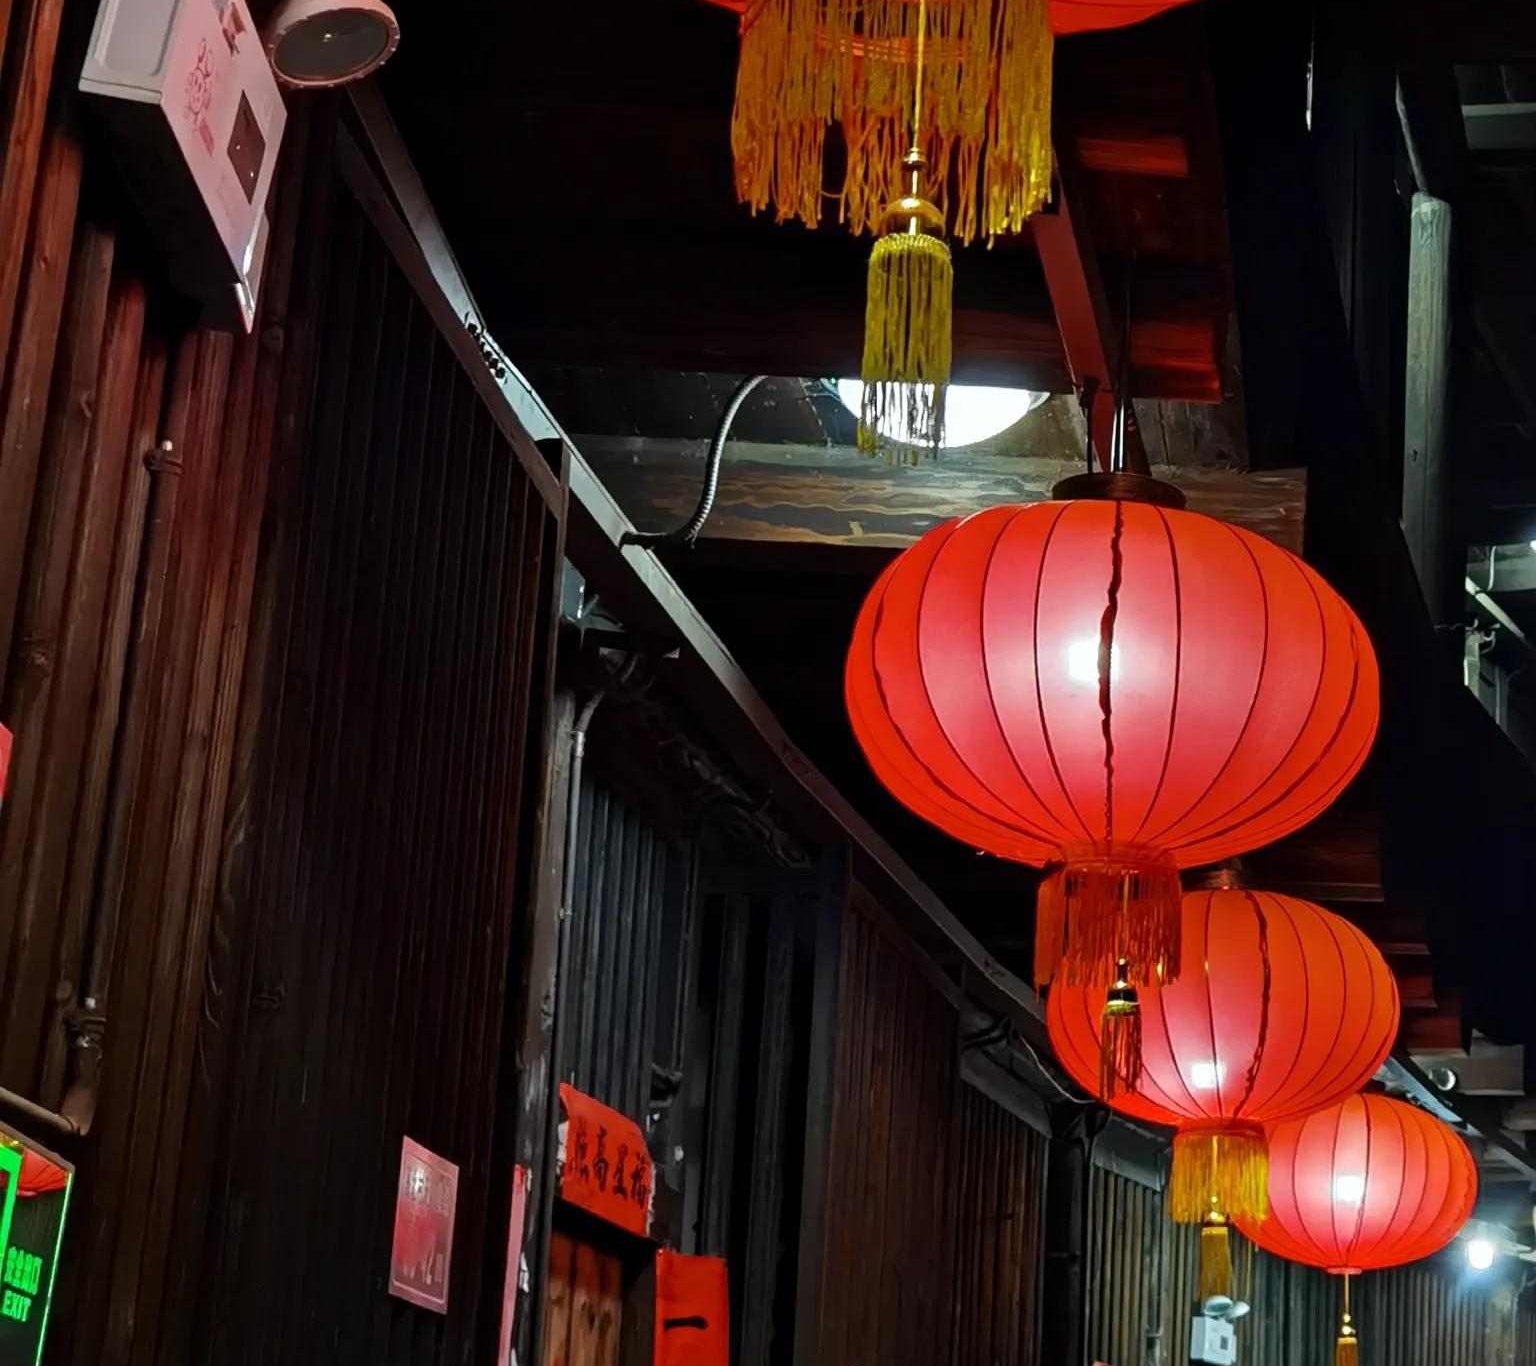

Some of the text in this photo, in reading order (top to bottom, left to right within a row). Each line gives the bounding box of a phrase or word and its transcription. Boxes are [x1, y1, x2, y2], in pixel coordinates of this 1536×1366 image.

[4, 1246, 43, 1296] 安全出口
[2, 1289, 32, 1322] EXIT
